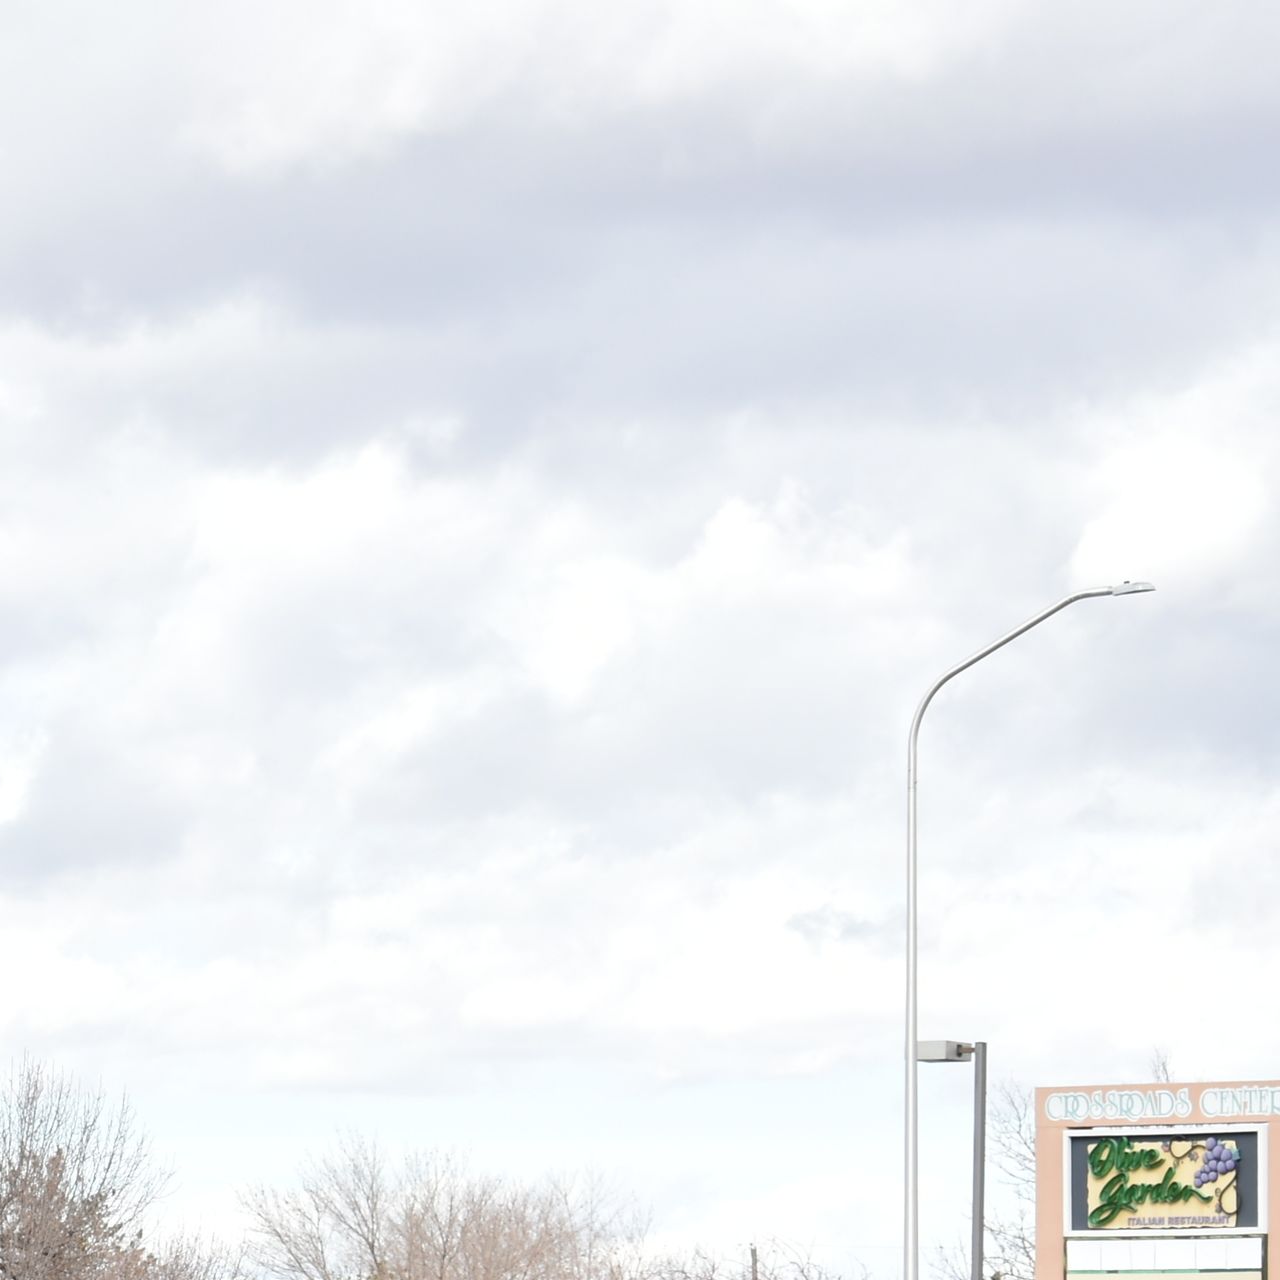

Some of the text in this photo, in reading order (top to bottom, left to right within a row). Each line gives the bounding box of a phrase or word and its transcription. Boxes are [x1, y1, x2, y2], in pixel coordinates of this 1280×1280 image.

[1046, 1089, 1192, 1120] CROSSROADS
[1089, 1136, 1166, 1178] Olive
[1088, 1167, 1213, 1226] Garden
[1127, 1216, 1231, 1226] ITALIAN RESTAURANT
